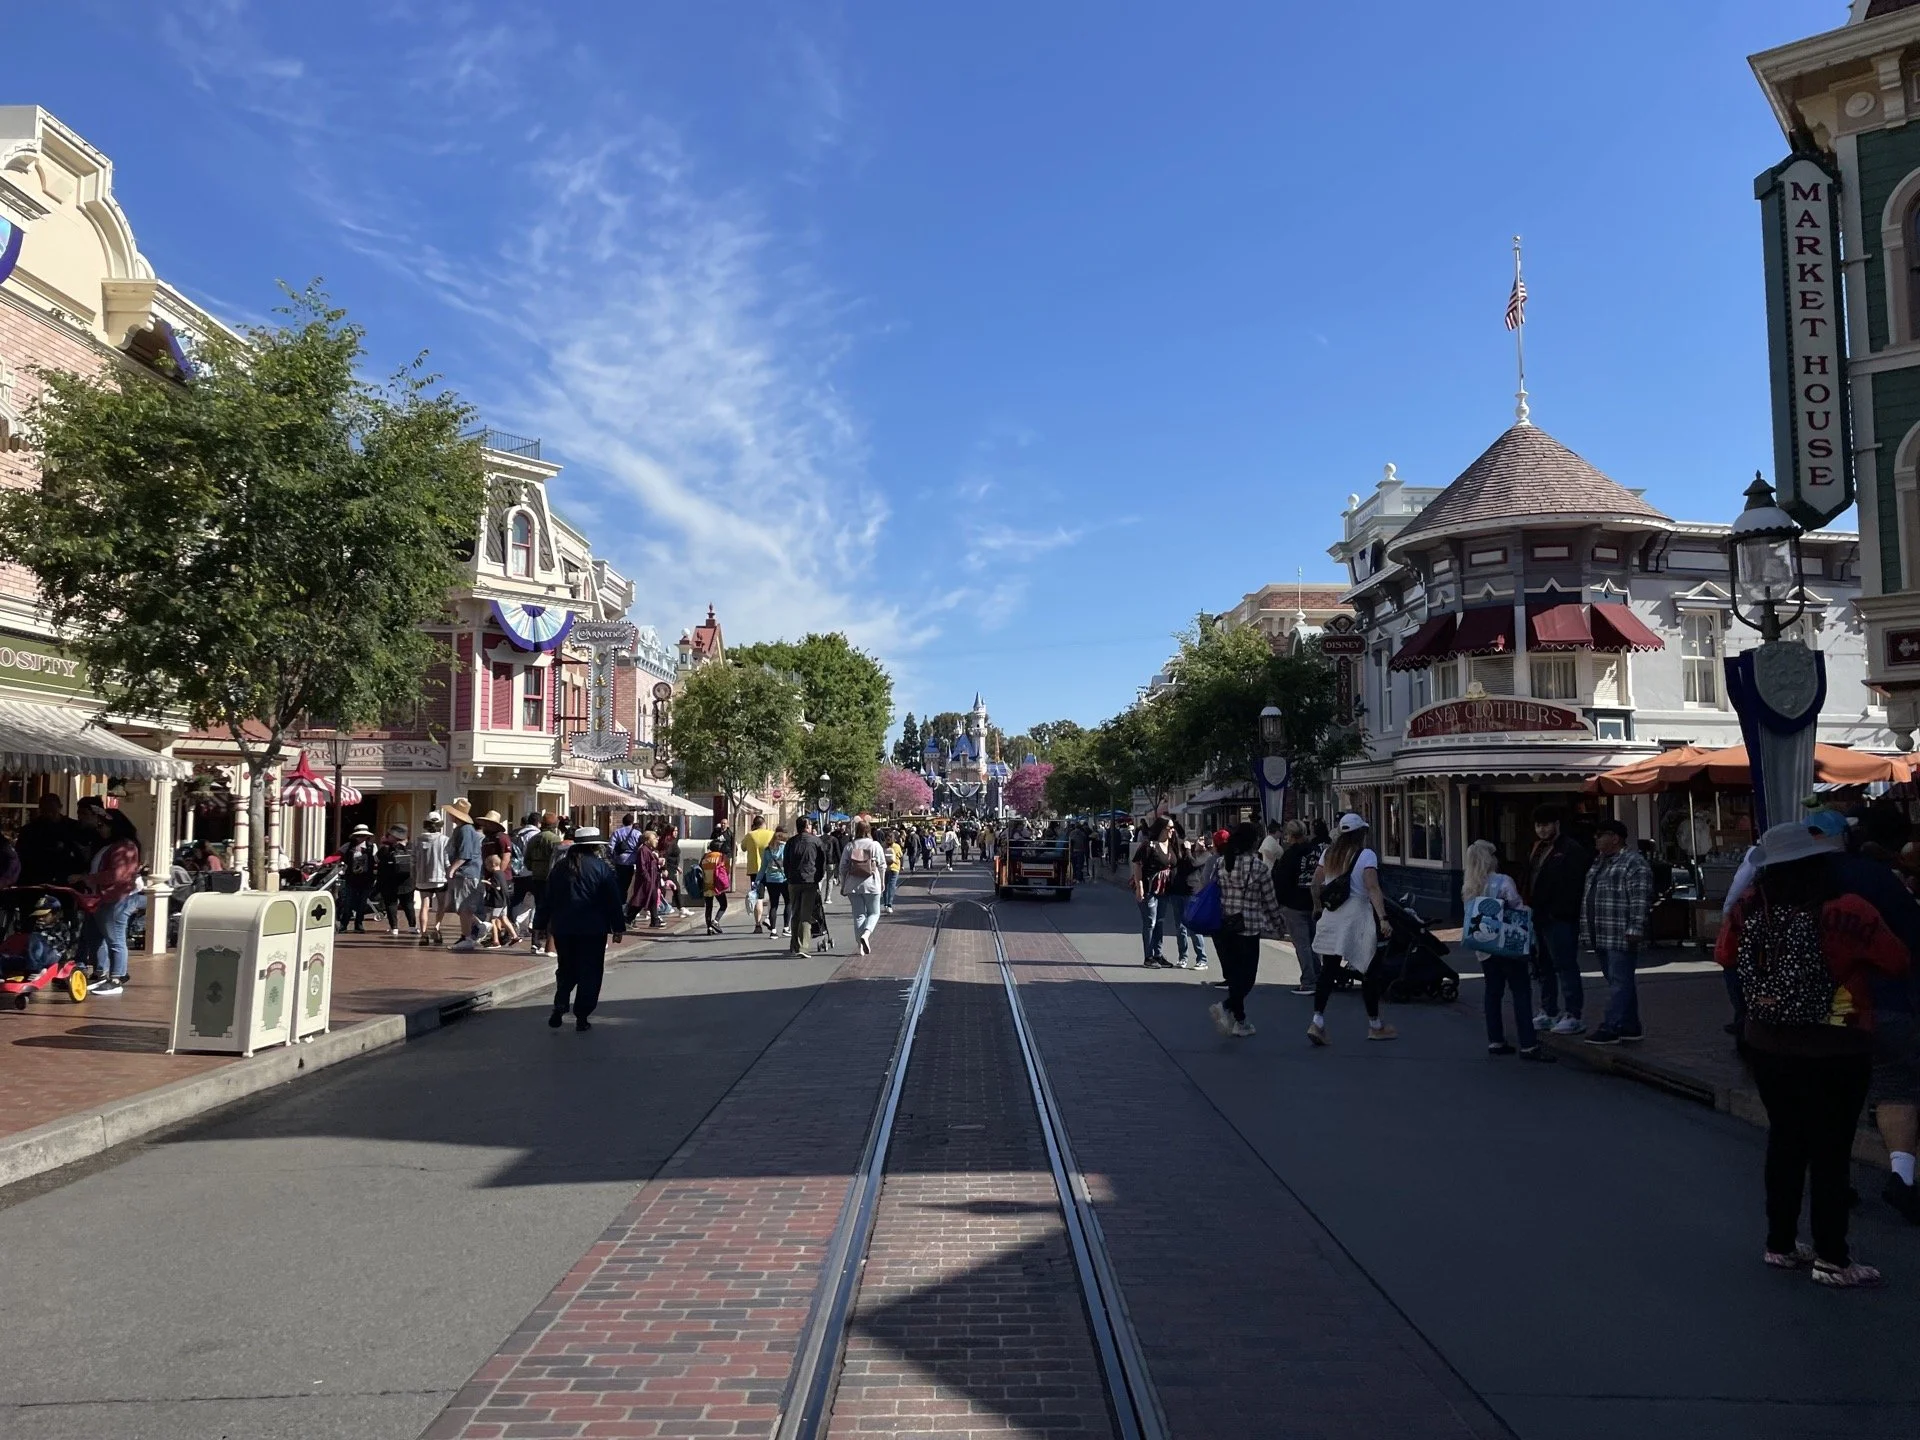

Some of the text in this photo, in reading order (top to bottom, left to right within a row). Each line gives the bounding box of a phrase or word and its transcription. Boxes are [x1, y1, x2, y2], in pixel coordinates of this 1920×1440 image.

[1790, 182, 1836, 487] MARKET HOUSE
[1325, 641, 1361, 649] DISNEY
[1417, 702, 1562, 733] DISNEY CLOTHIERS
[303, 745, 386, 760] ARTION
